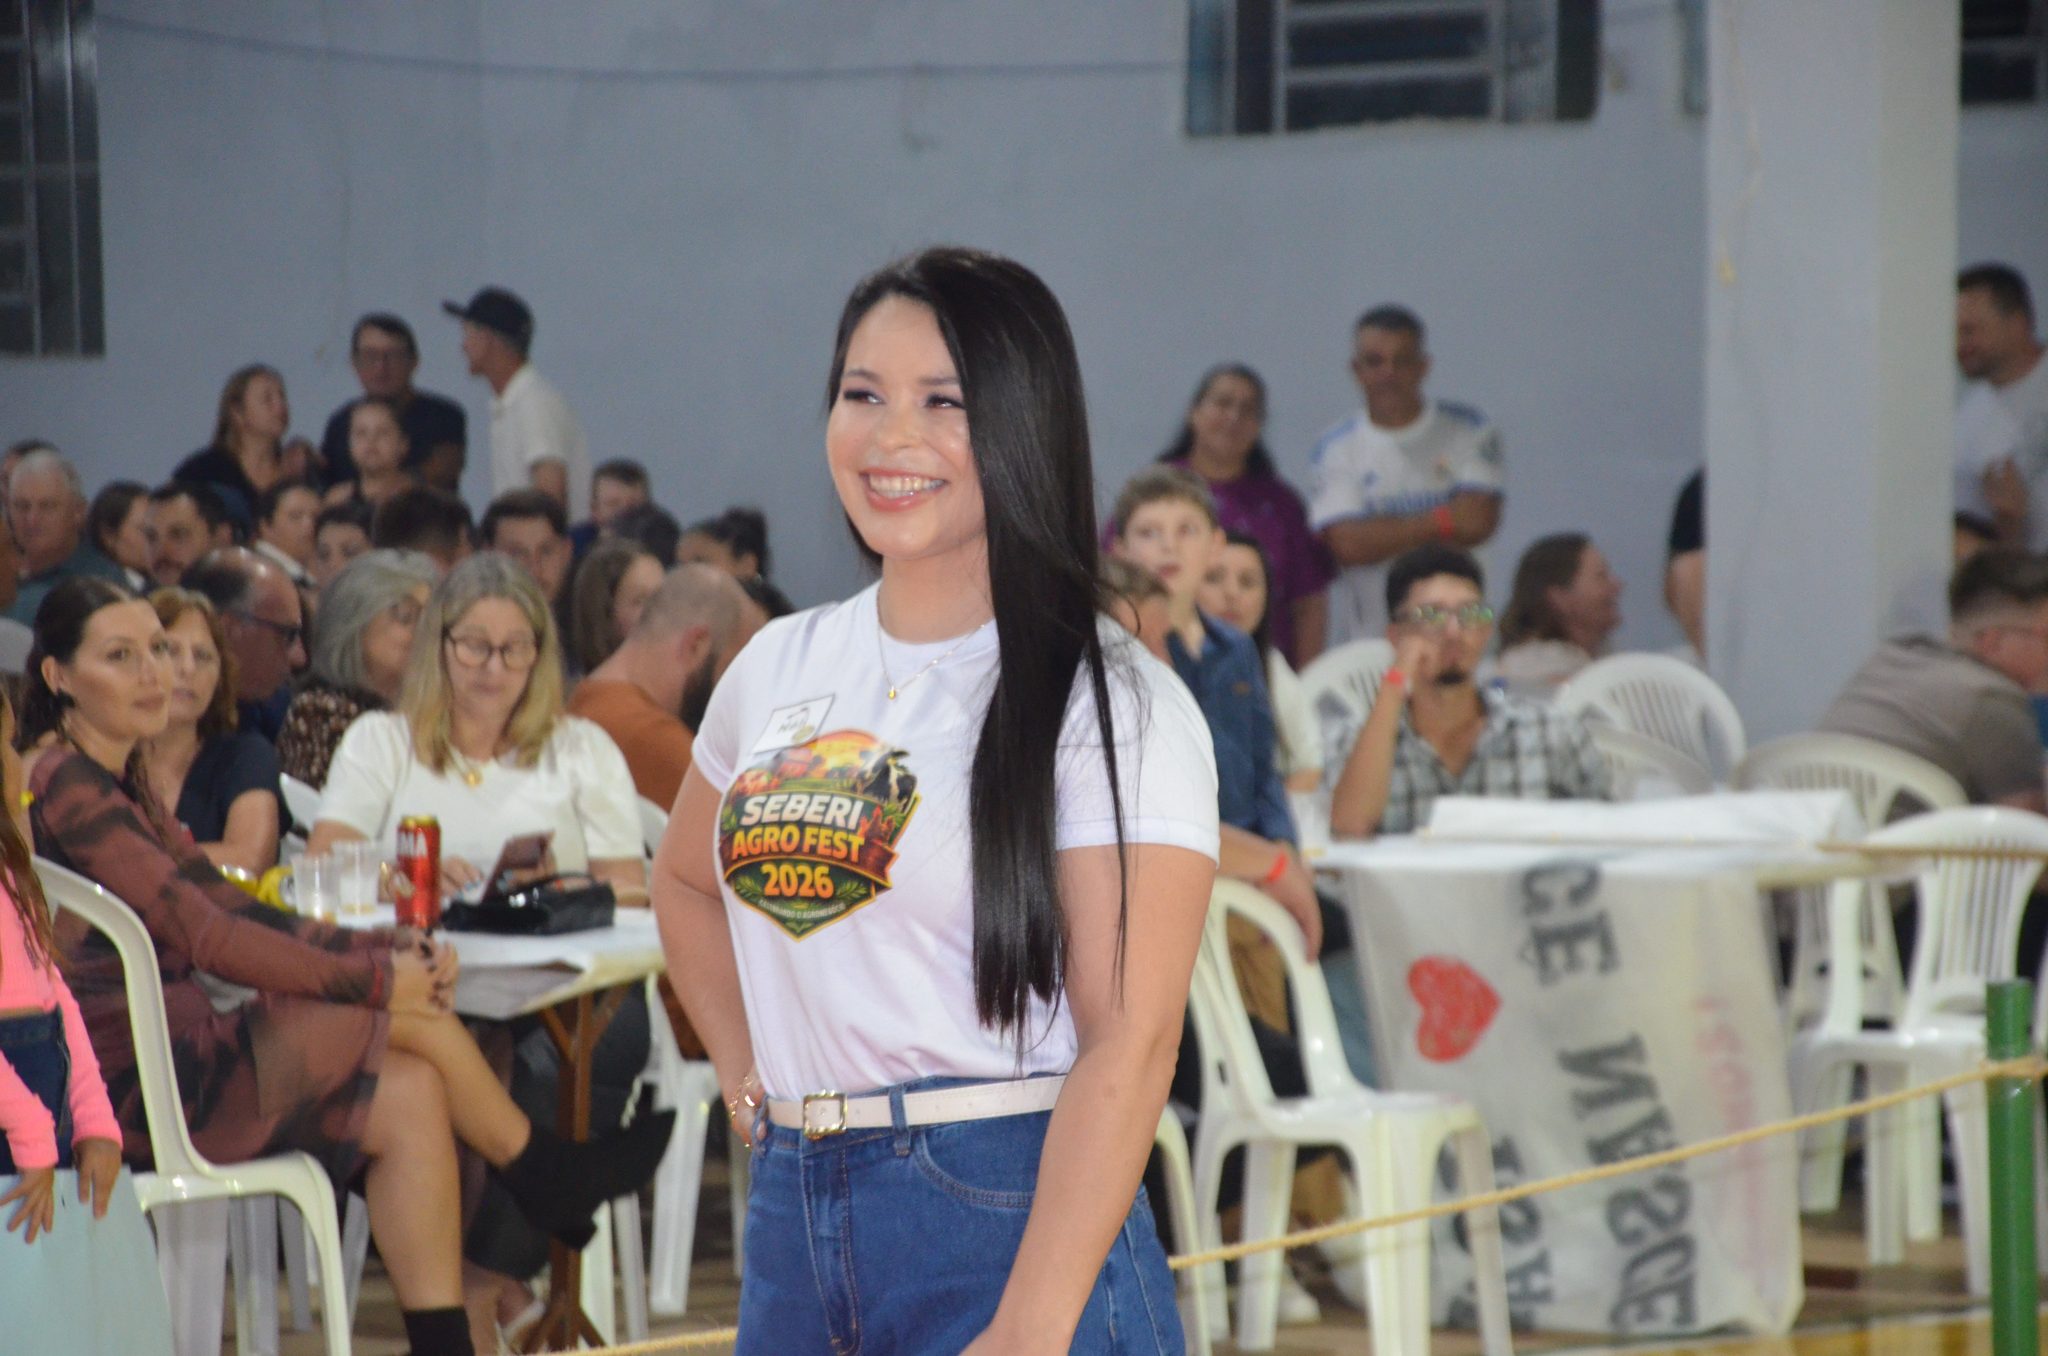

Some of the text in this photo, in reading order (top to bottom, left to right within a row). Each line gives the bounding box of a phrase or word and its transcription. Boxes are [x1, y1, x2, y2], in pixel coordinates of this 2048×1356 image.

[740, 794, 864, 829] SEBERI
[731, 824, 865, 863] AGRO FEST
[761, 863, 834, 898] 2026
